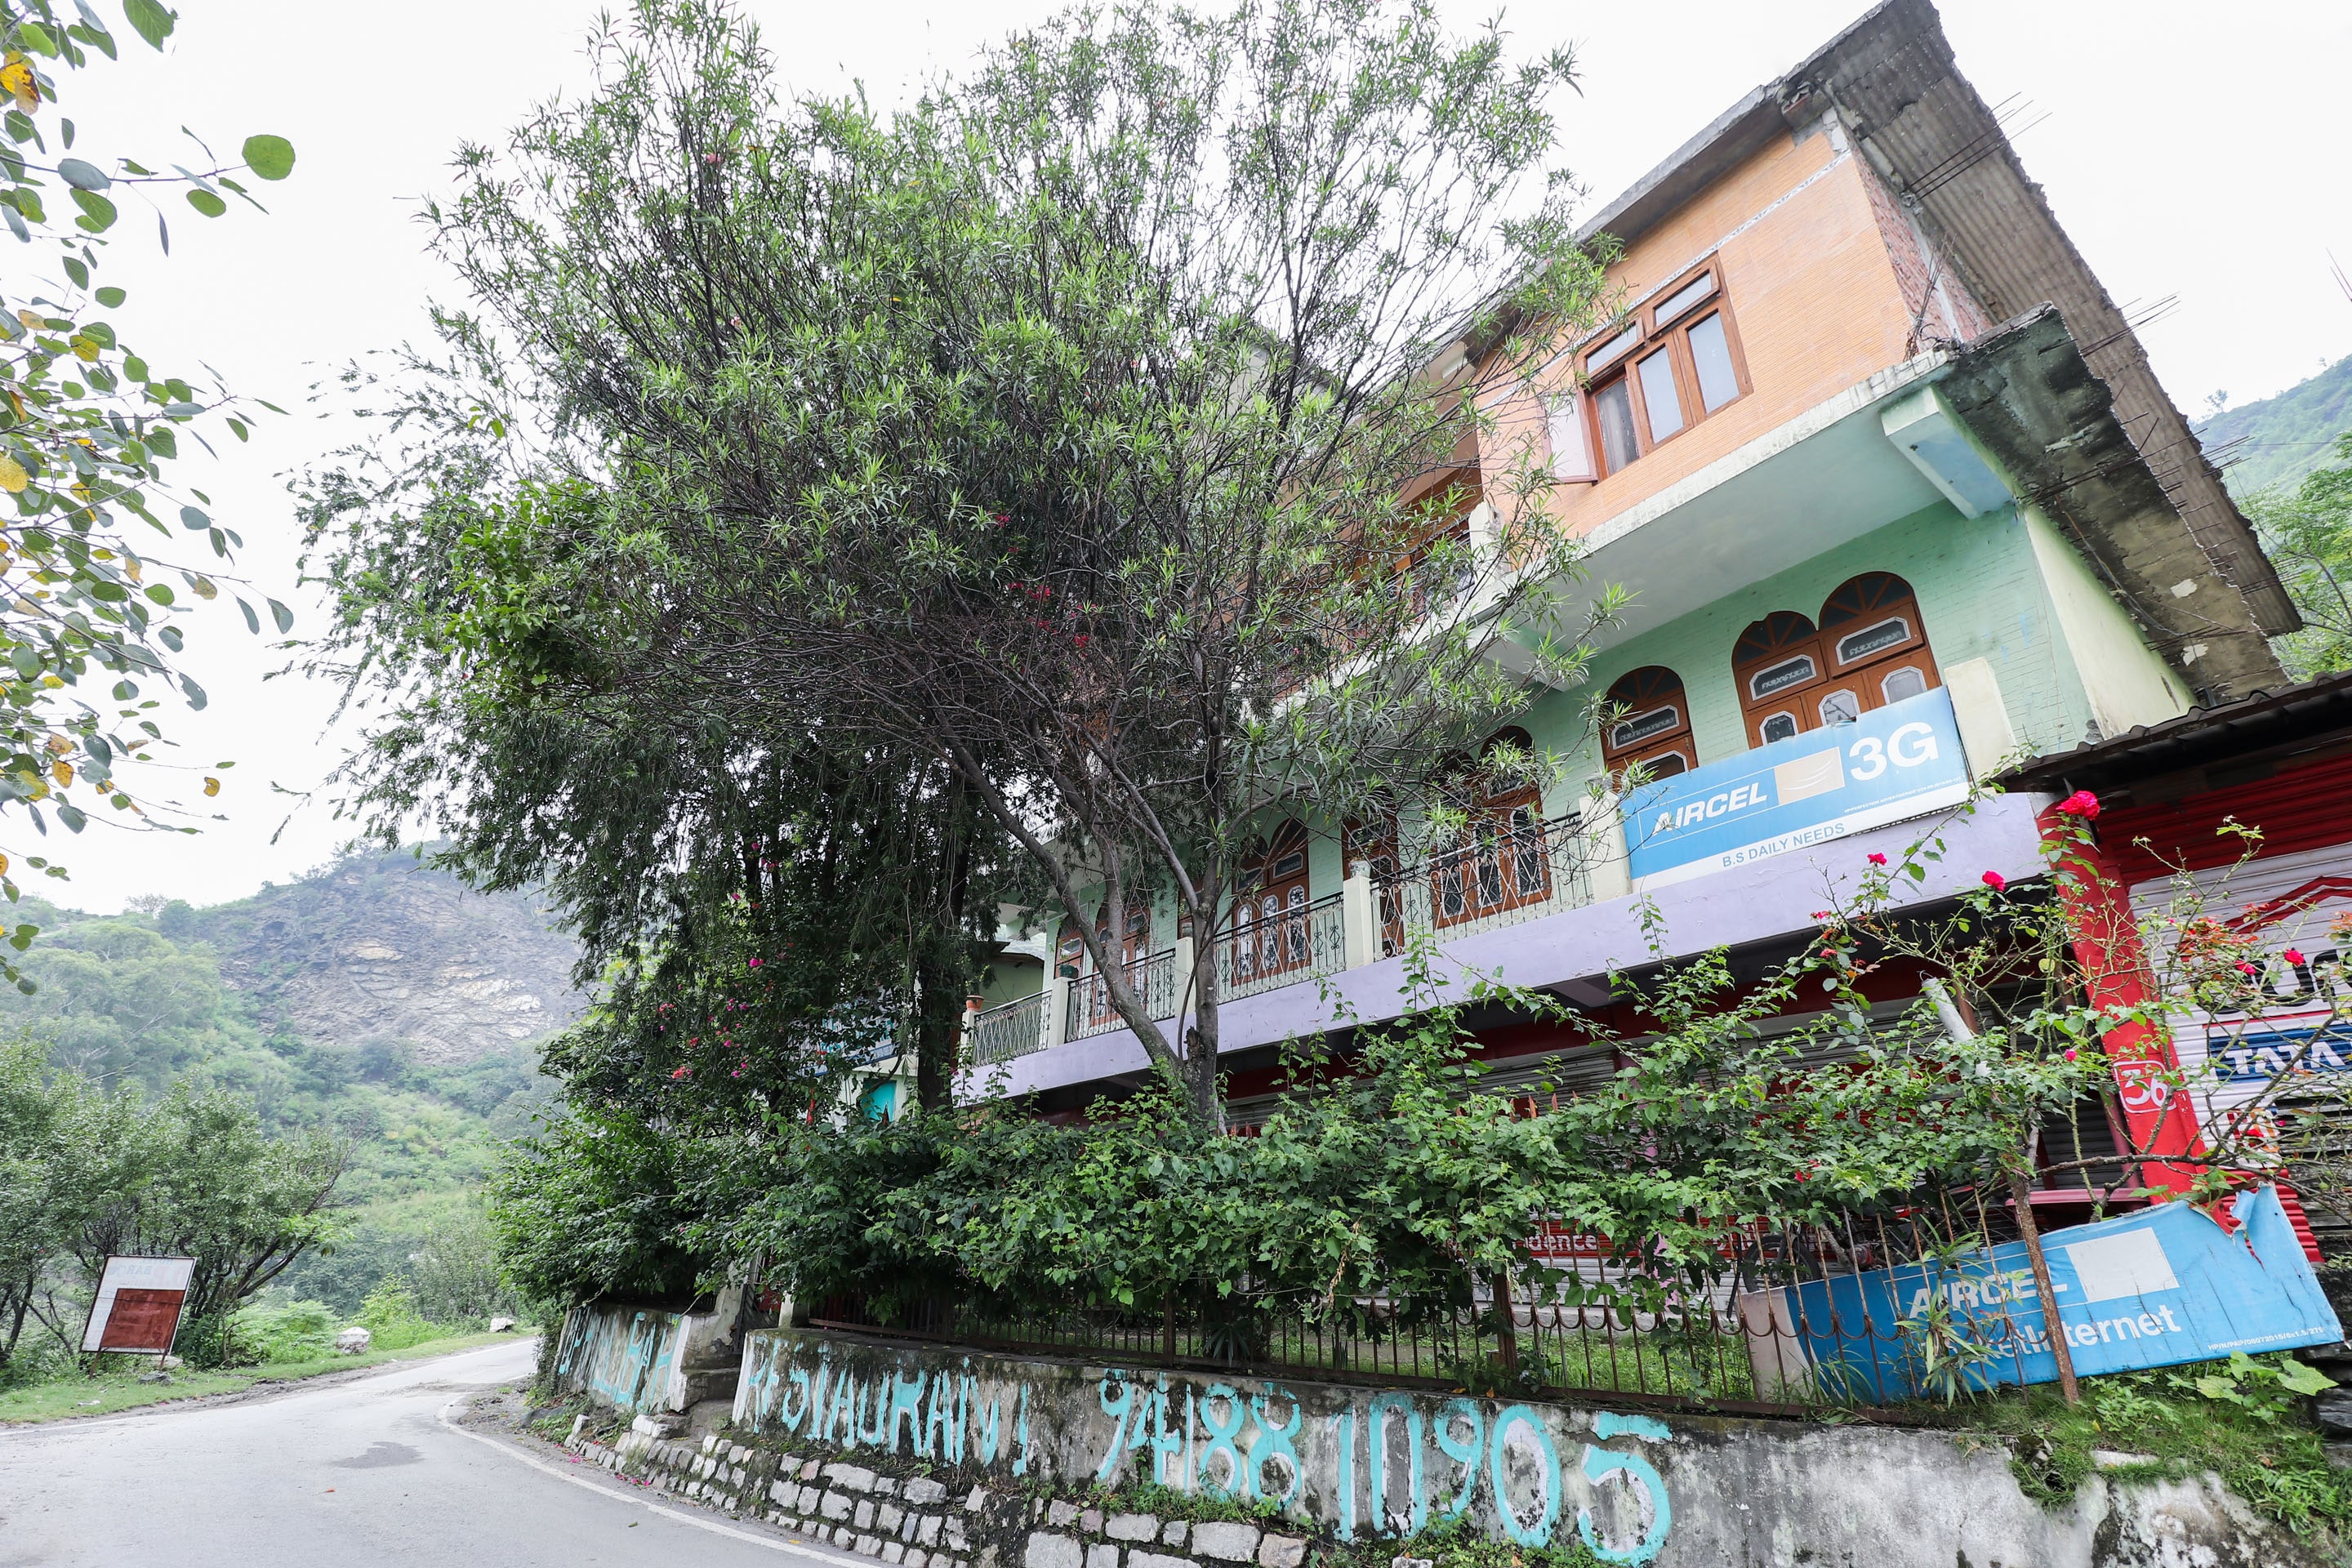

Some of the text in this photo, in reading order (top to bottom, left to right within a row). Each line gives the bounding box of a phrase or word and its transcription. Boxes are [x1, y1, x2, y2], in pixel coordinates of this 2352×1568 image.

[1653, 722, 1940, 833] AIRCEL 3G
[1722, 822, 1846, 867] B.S DAILY NEEDS
[2225, 1041, 2346, 1075] TATA
[2121, 1069, 2171, 1108] 36
